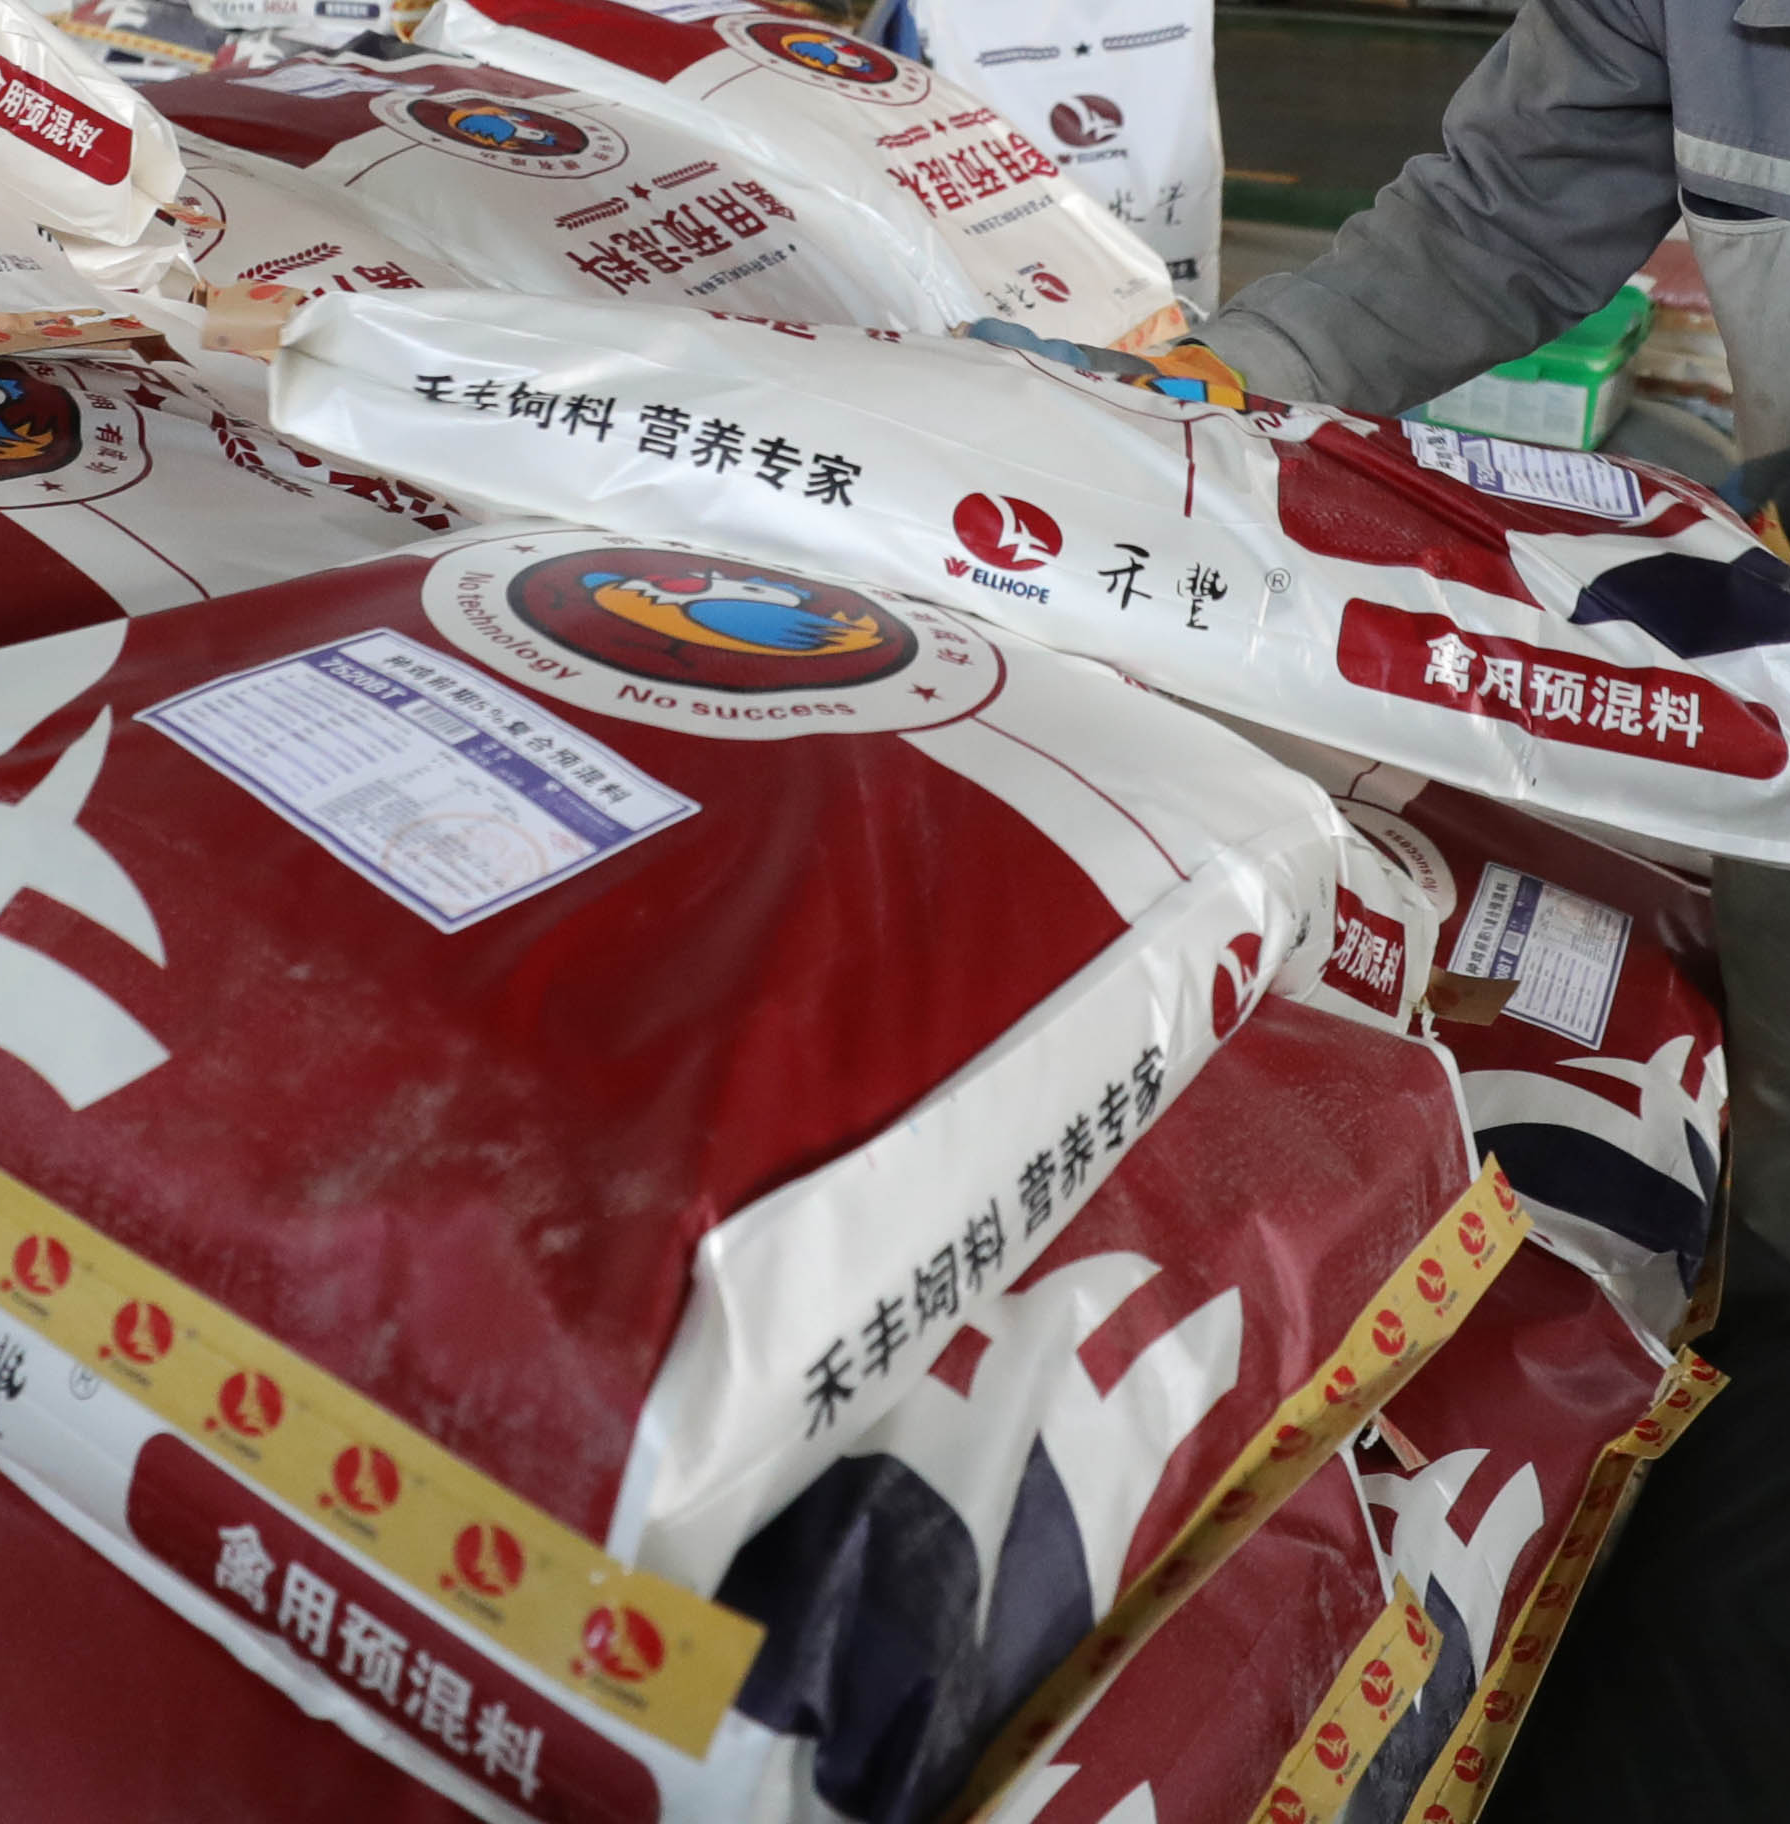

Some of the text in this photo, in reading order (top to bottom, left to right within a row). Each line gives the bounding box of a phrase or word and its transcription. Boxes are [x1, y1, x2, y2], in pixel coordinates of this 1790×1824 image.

[565, 179, 798, 297] 禽用预混料
[636, 402, 866, 509] 营养专家
[942, 554, 1052, 605] WELLHOPE
[456, 569, 859, 722] No technology No success
[1422, 630, 1708, 750] 禽用预混料
[800, 1042, 1168, 1440] 禾丰饲料 营养专家
[211, 1521, 545, 1800] 禽用预混料
